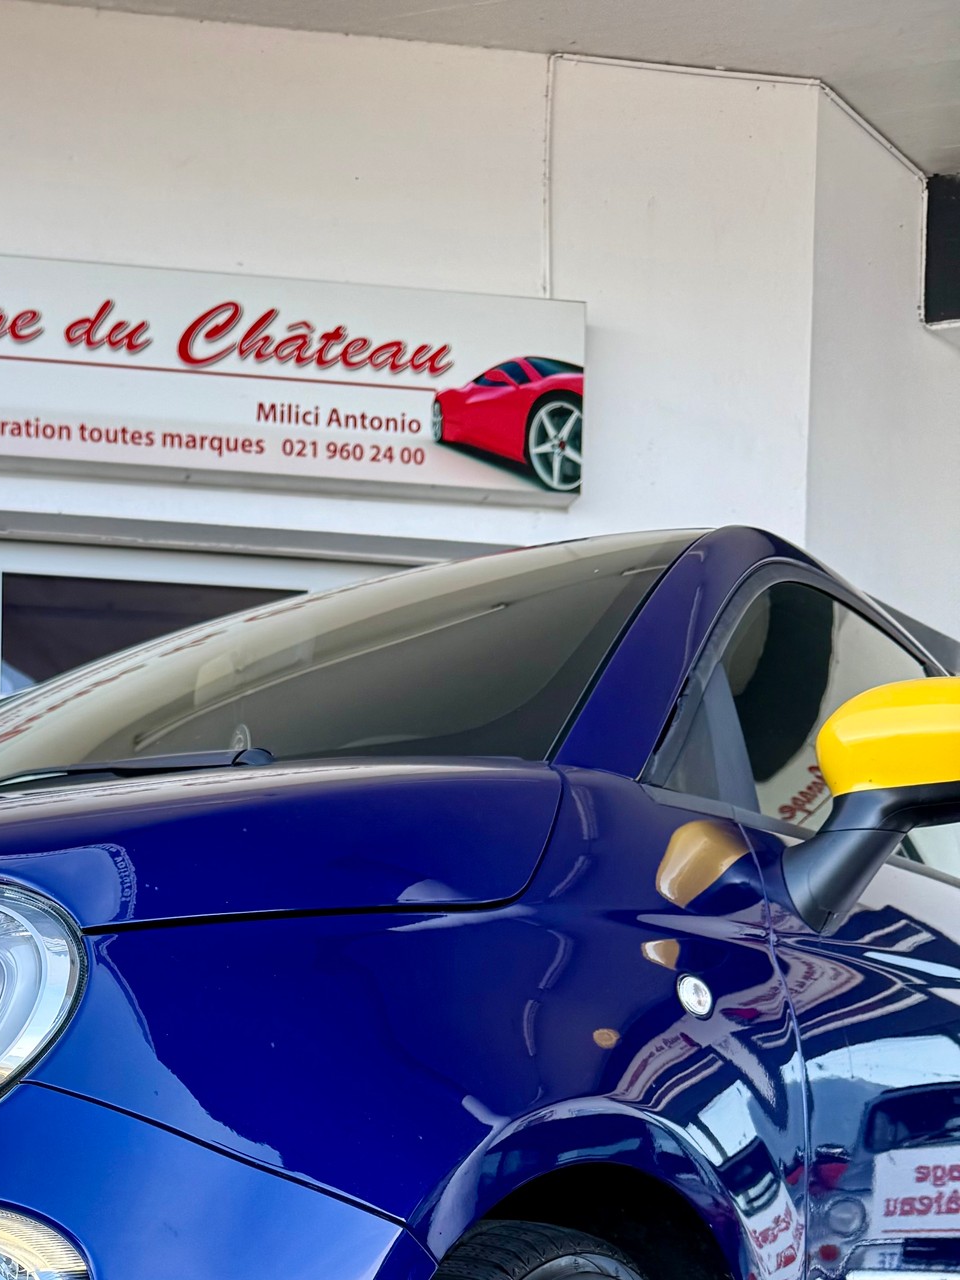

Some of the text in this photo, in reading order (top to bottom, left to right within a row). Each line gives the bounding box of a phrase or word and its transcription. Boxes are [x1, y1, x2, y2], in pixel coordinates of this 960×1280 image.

[64, 299, 152, 355] du
[176, 300, 454, 377] Château
[256, 402, 422, 434] Milici Antonio
[78, 422, 155, 447] toutes
[161, 430, 266, 458] marques
[281, 438, 426, 466] 021 960 24 00
